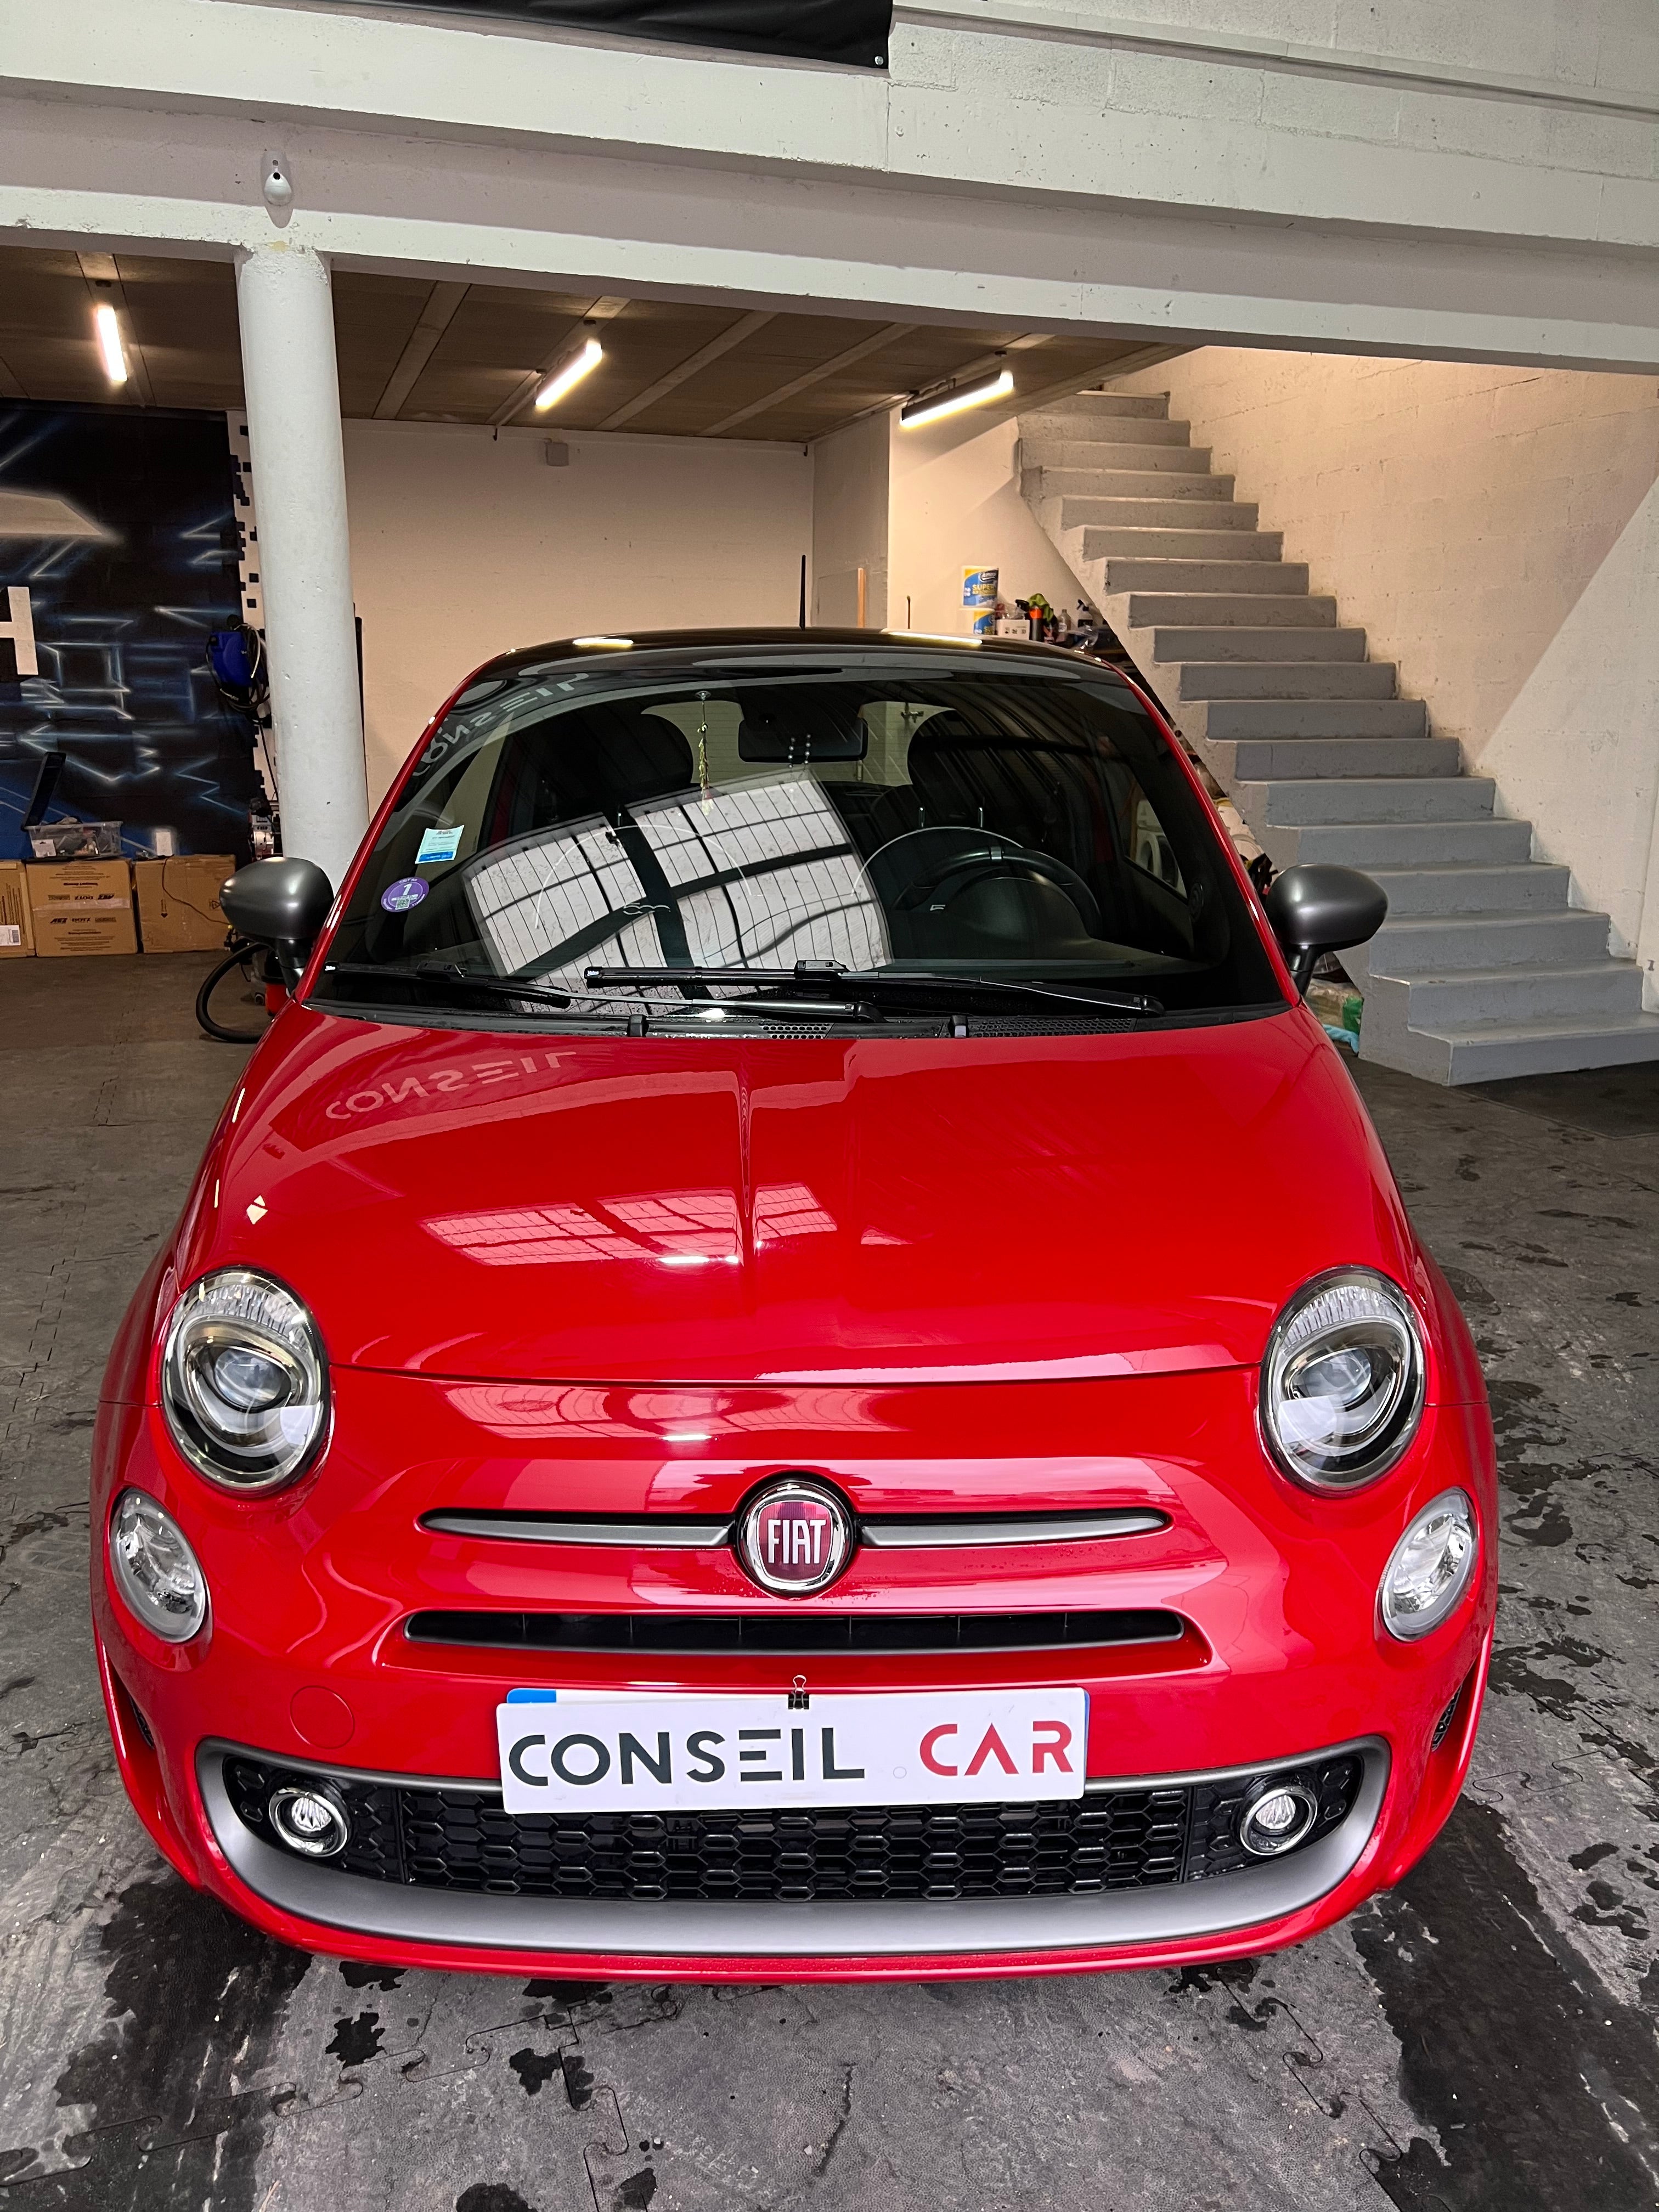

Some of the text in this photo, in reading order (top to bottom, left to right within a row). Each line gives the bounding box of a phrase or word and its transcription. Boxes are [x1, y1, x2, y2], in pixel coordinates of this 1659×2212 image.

[403, 883, 412, 895] 1
[768, 1519, 826, 1564] FIAT
[509, 1720, 1074, 1786] CONSEIL CAR
